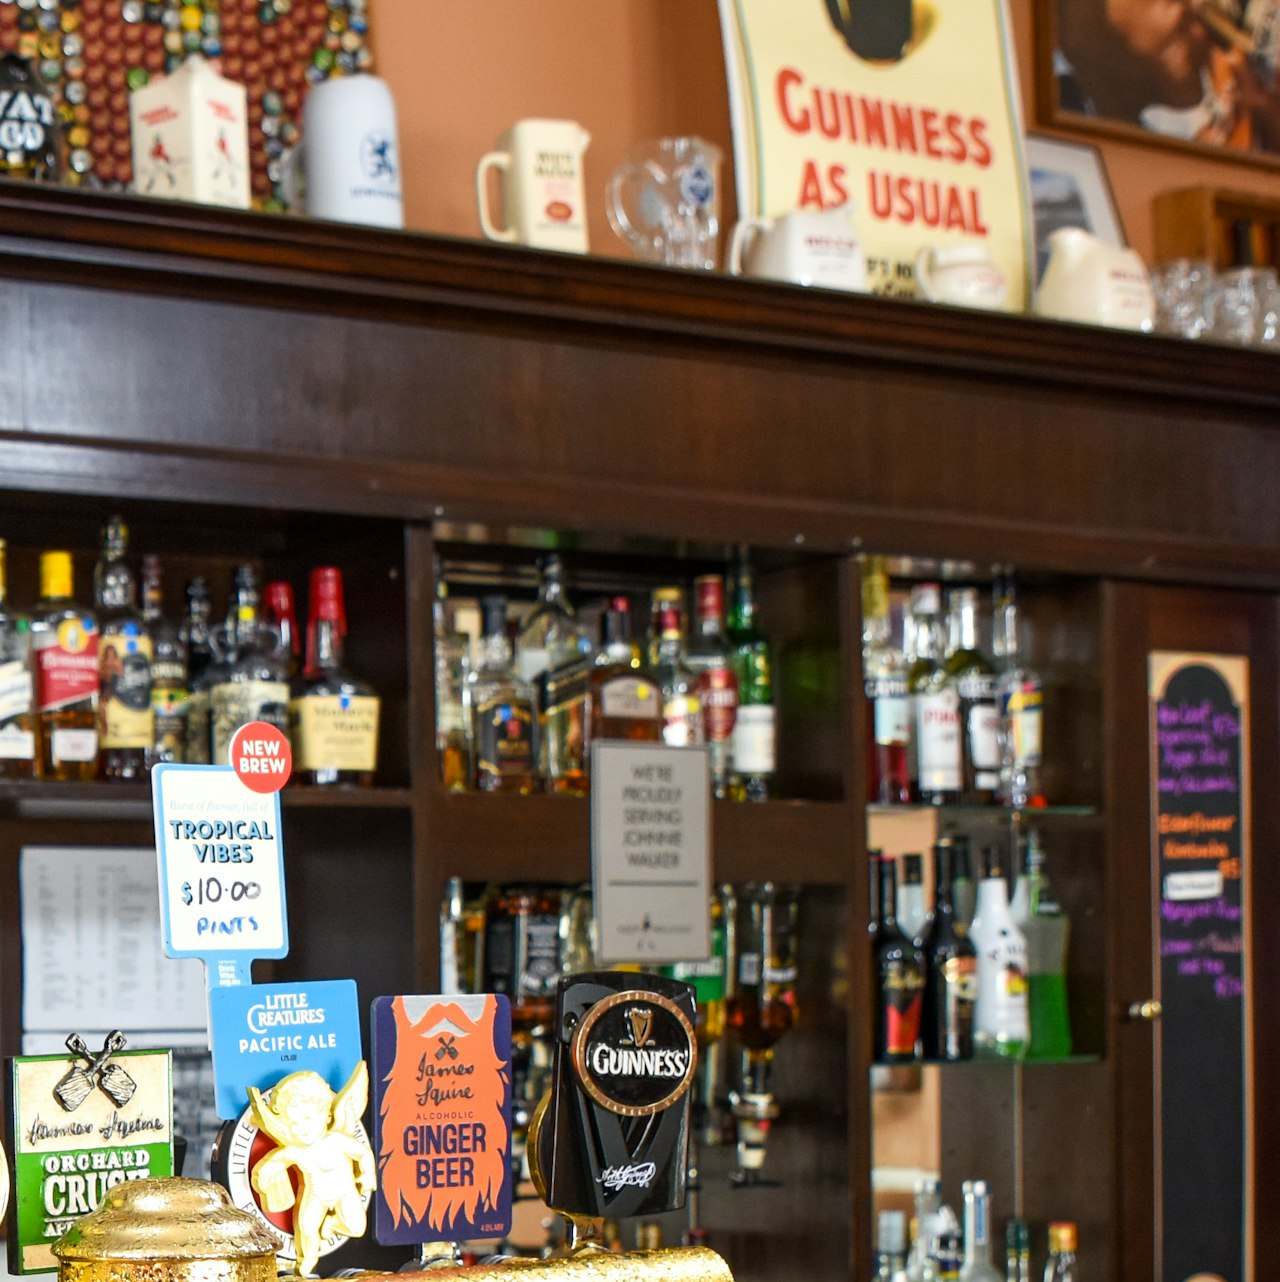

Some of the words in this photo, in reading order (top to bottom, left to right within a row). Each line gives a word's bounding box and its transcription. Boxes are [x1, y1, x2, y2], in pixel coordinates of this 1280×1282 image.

[776, 67, 994, 168] GUINNESS
[799, 160, 849, 212] AS
[868, 169, 989, 239] USUAL
[242, 740, 281, 757] NEW
[239, 757, 286, 774] BREW
[169, 820, 273, 840] TROPICAL
[192, 843, 254, 864] VIBES
[197, 915, 259, 936] PINTS
[265, 993, 308, 1010] LITTLE
[247, 1004, 326, 1035] CREATURES
[239, 1035, 303, 1053] PACIFIC
[307, 1033, 337, 1049] ALE
[416, 1052, 475, 1082] James
[592, 1042, 687, 1078] GUINNESS
[415, 1080, 475, 1107] Squire
[416, 1111, 474, 1121] ALCOHOLIC
[232, 1122, 256, 1175] LITTLE
[403, 1123, 486, 1155] GINGER
[43, 1149, 151, 1174] ORCHARD
[416, 1157, 475, 1189] BEER
[43, 1168, 151, 1216] CRU
